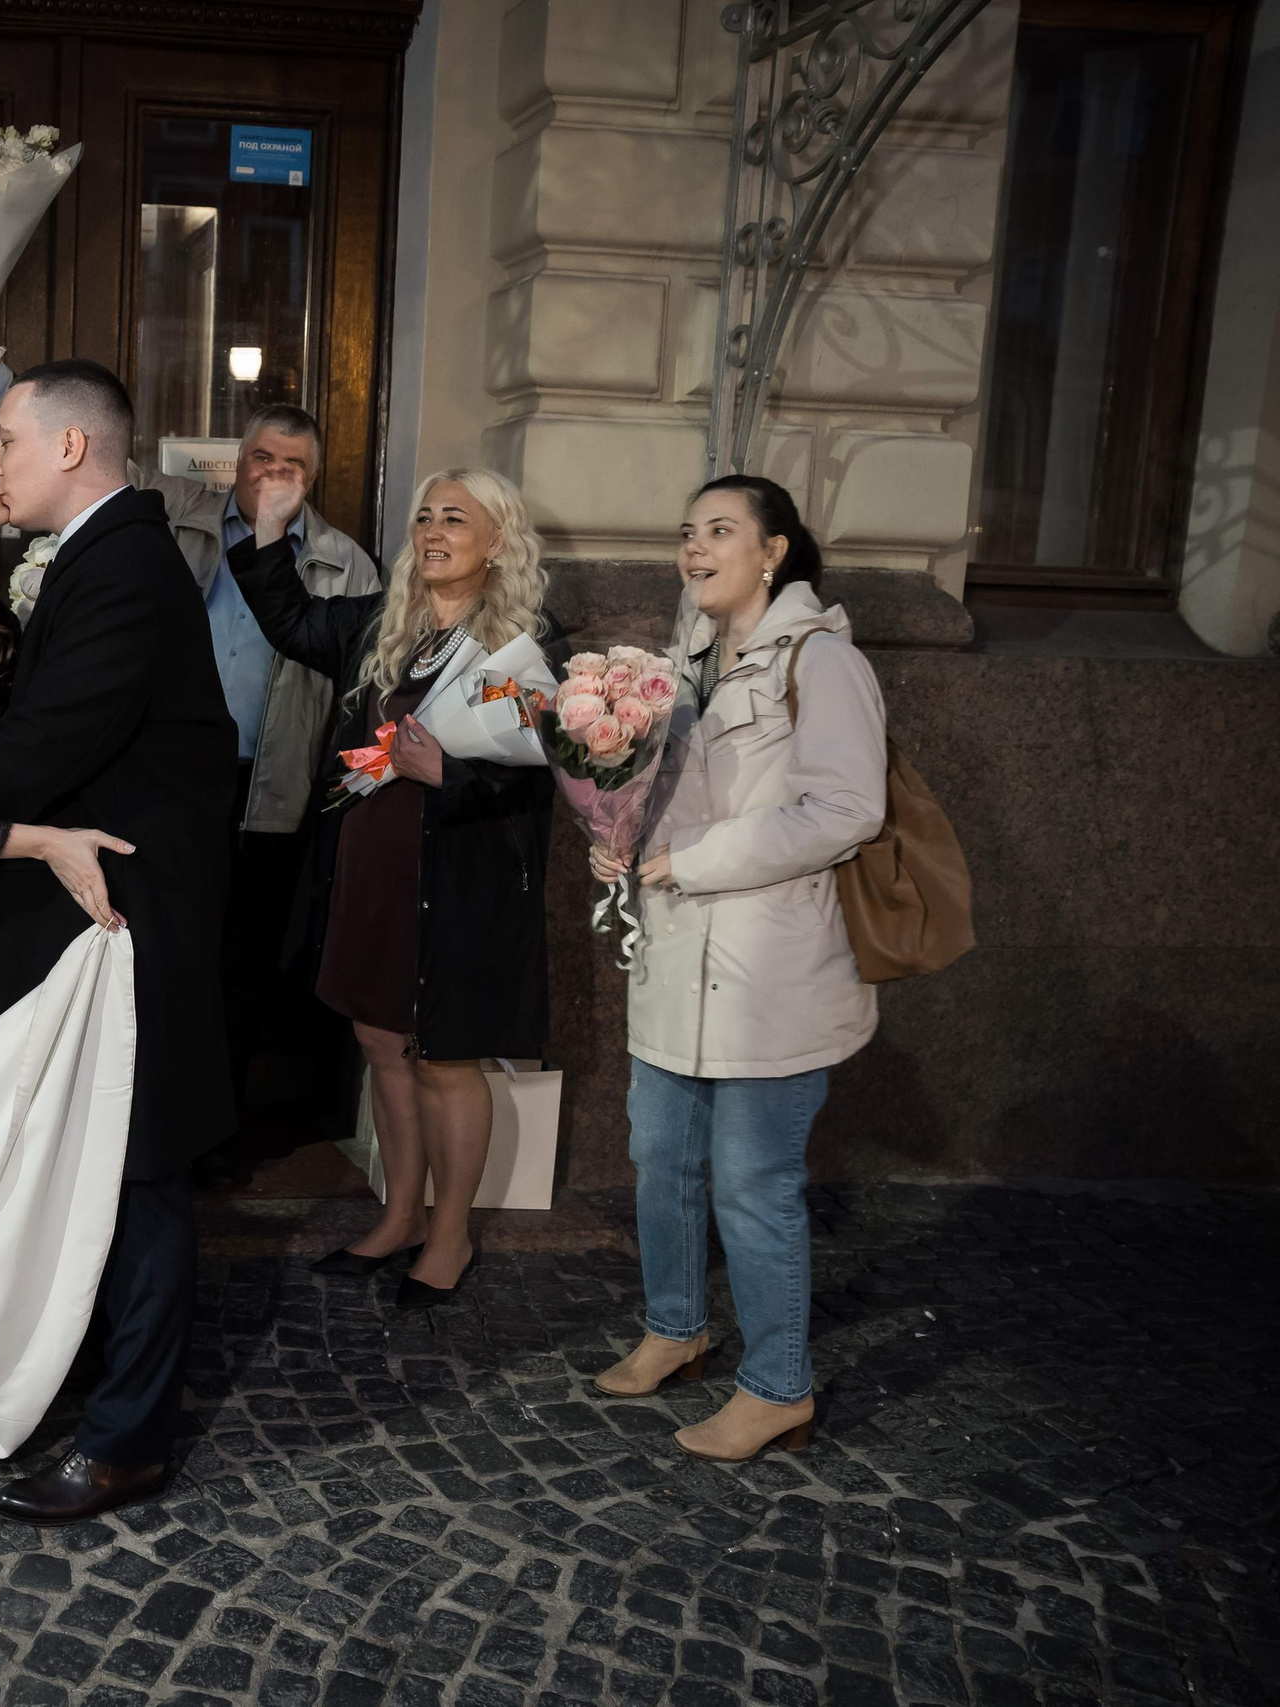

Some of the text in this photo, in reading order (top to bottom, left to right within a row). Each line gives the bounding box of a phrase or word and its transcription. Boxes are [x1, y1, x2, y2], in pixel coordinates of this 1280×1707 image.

[239, 141, 302, 152] ПОД ОХРАНОЙ
[187, 458, 236, 469] Апости
